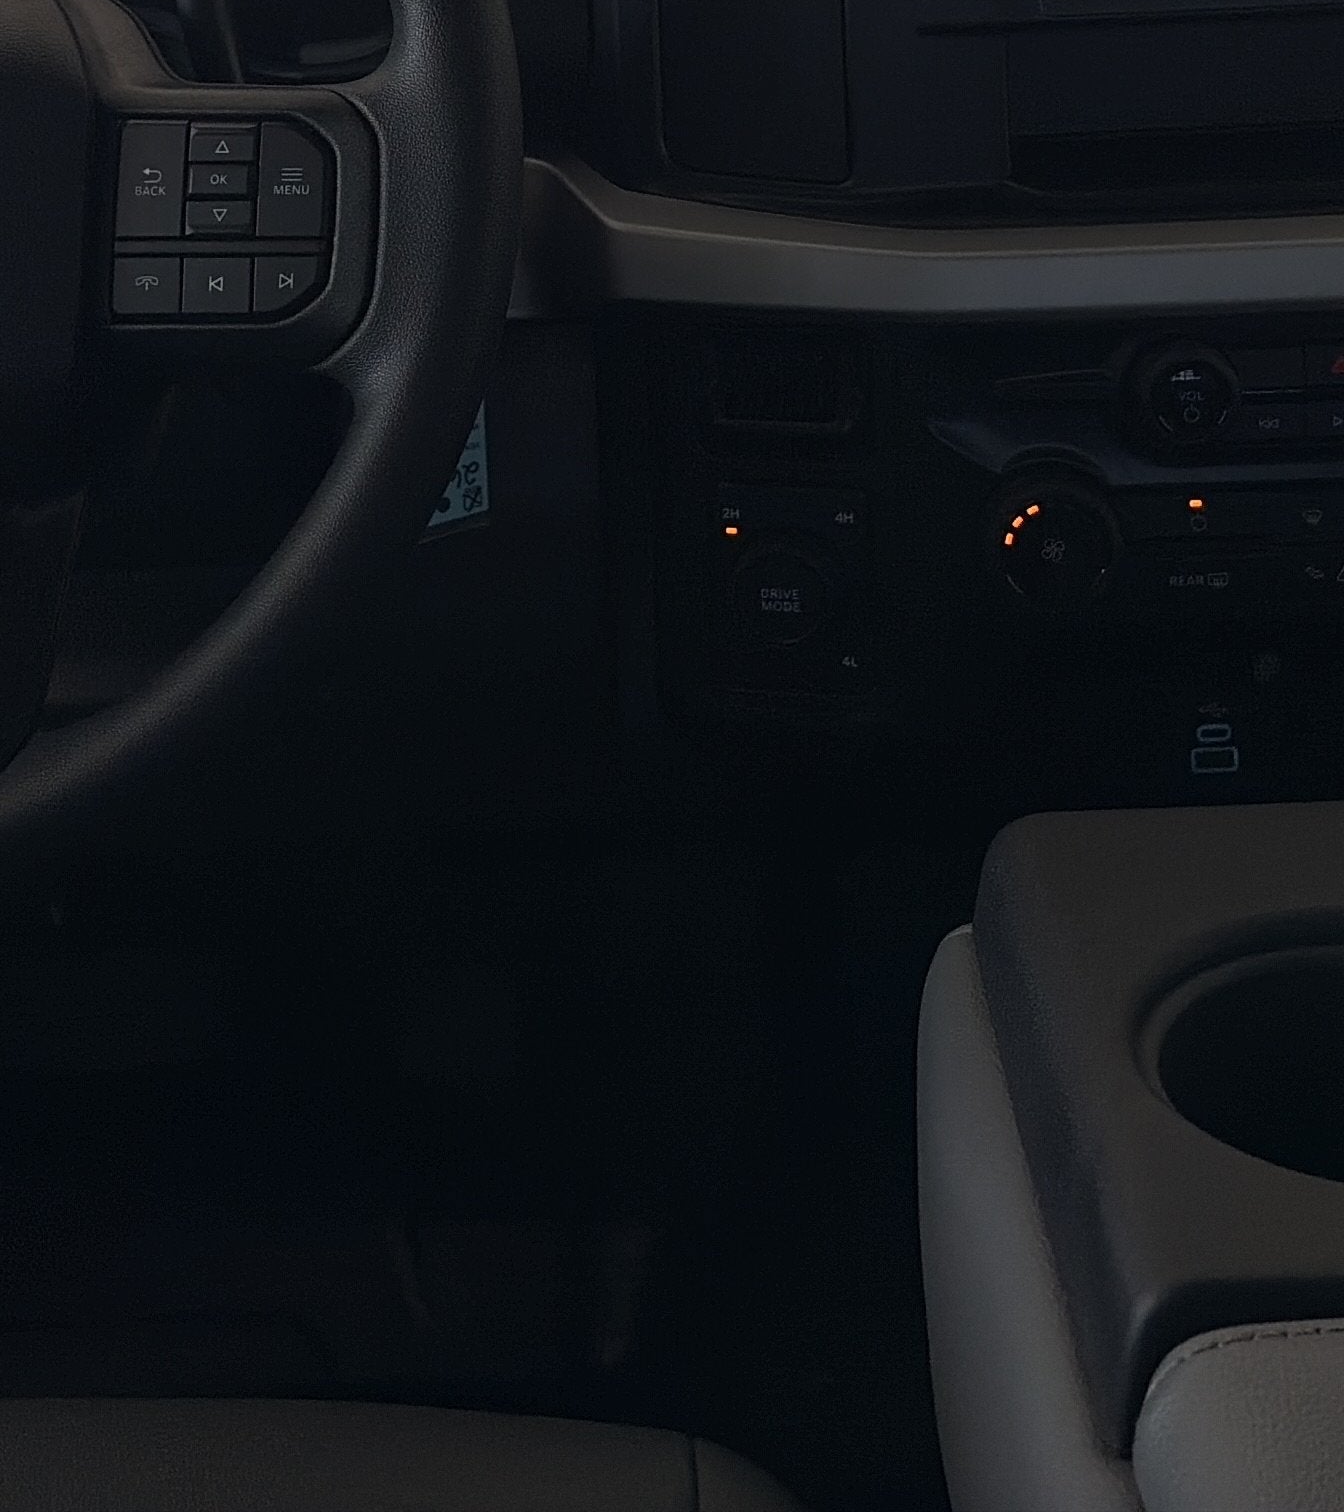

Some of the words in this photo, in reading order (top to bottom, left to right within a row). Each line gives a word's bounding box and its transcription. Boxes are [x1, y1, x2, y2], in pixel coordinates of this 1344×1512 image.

[209, 173, 229, 186] OK
[134, 185, 167, 197] BACK
[272, 184, 310, 196] MENU
[759, 587, 800, 600] DRIVE
[761, 600, 802, 613] MODE
